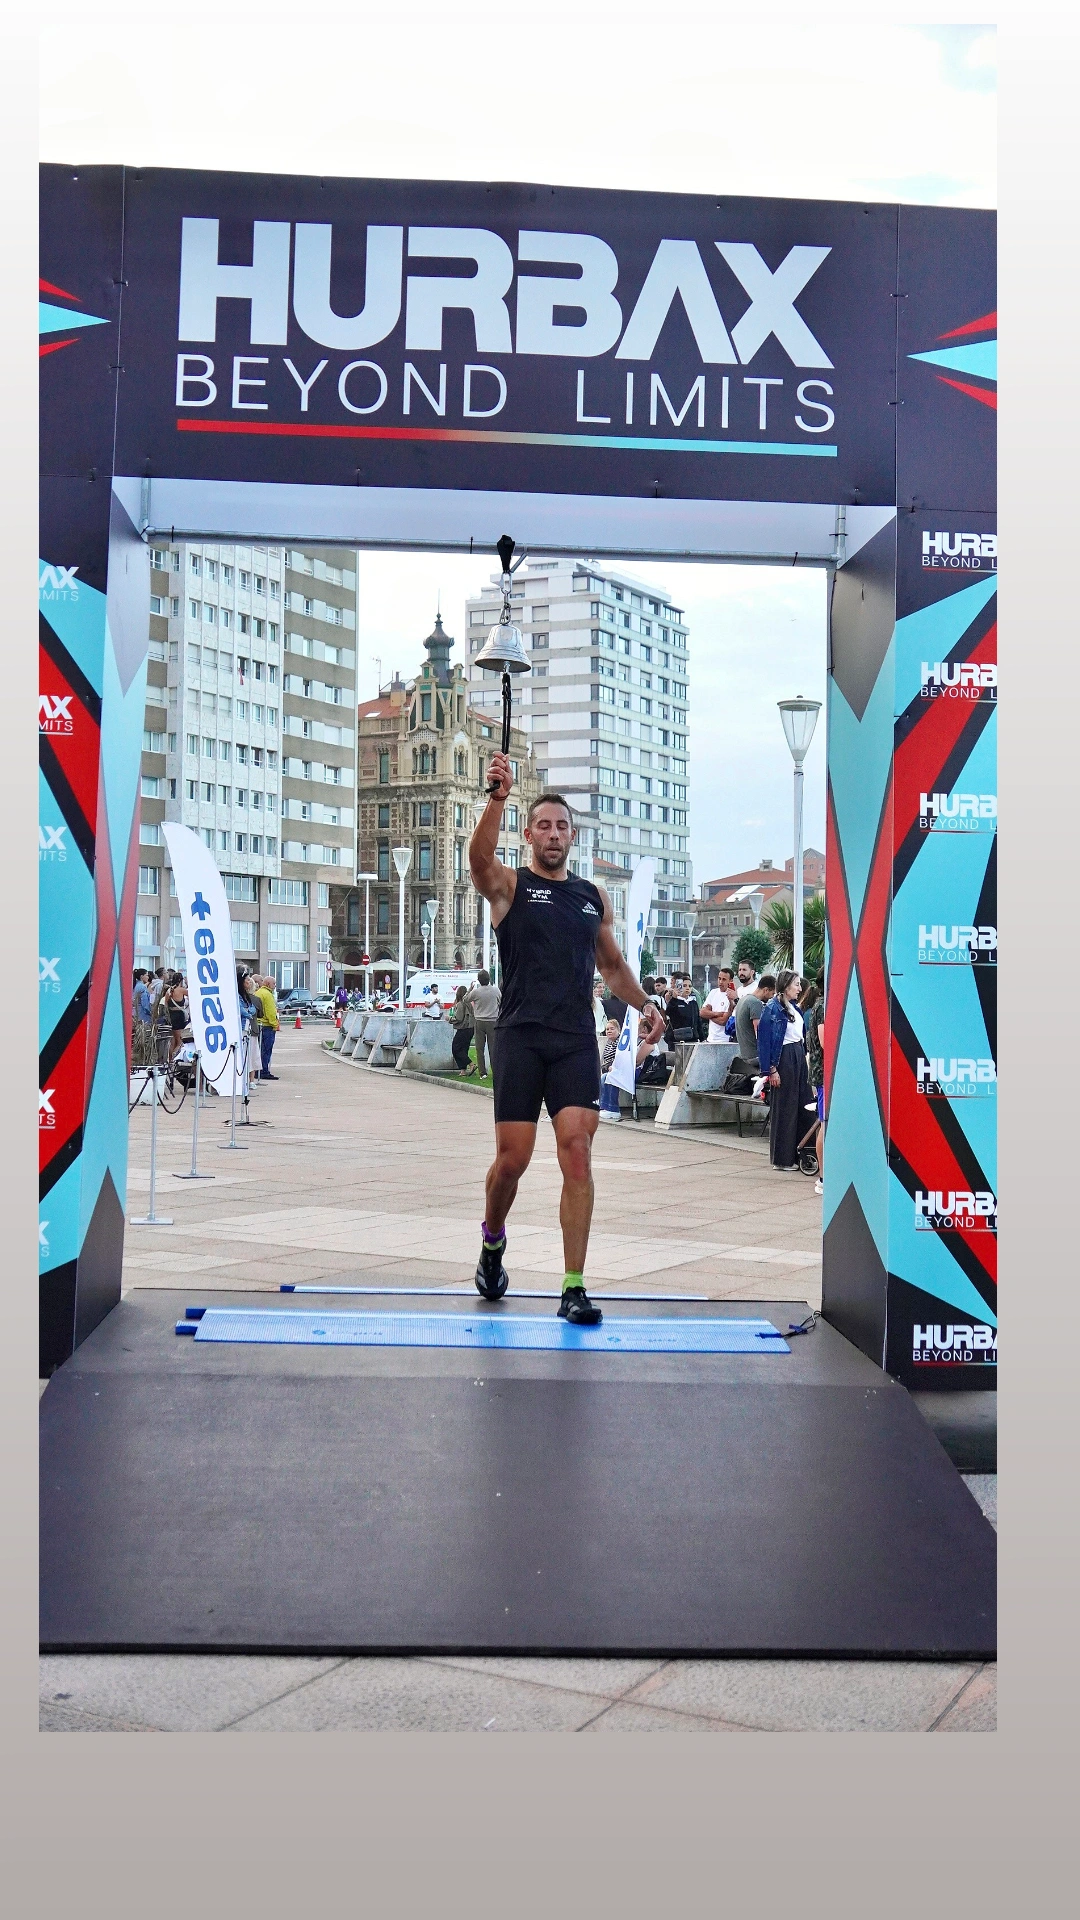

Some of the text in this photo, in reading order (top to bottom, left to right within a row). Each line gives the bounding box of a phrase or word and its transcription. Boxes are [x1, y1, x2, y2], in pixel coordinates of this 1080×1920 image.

[178, 217, 835, 368] HURBAX
[175, 353, 835, 433] BEYOND LIMITS
[921, 555, 981, 569] BEYOND
[40, 590, 79, 602] MITS
[920, 687, 980, 699] BEYOND
[919, 817, 979, 830] BEYOND
[526, 887, 552, 895] HYBRID
[917, 950, 978, 962] BEYOND
[916, 1057, 997, 1083] HURB
[916, 1082, 976, 1094] BEYOND
[915, 1191, 997, 1216] HURB
[914, 1215, 975, 1228] BEYOND
[912, 1349, 973, 1362] BEYOND
